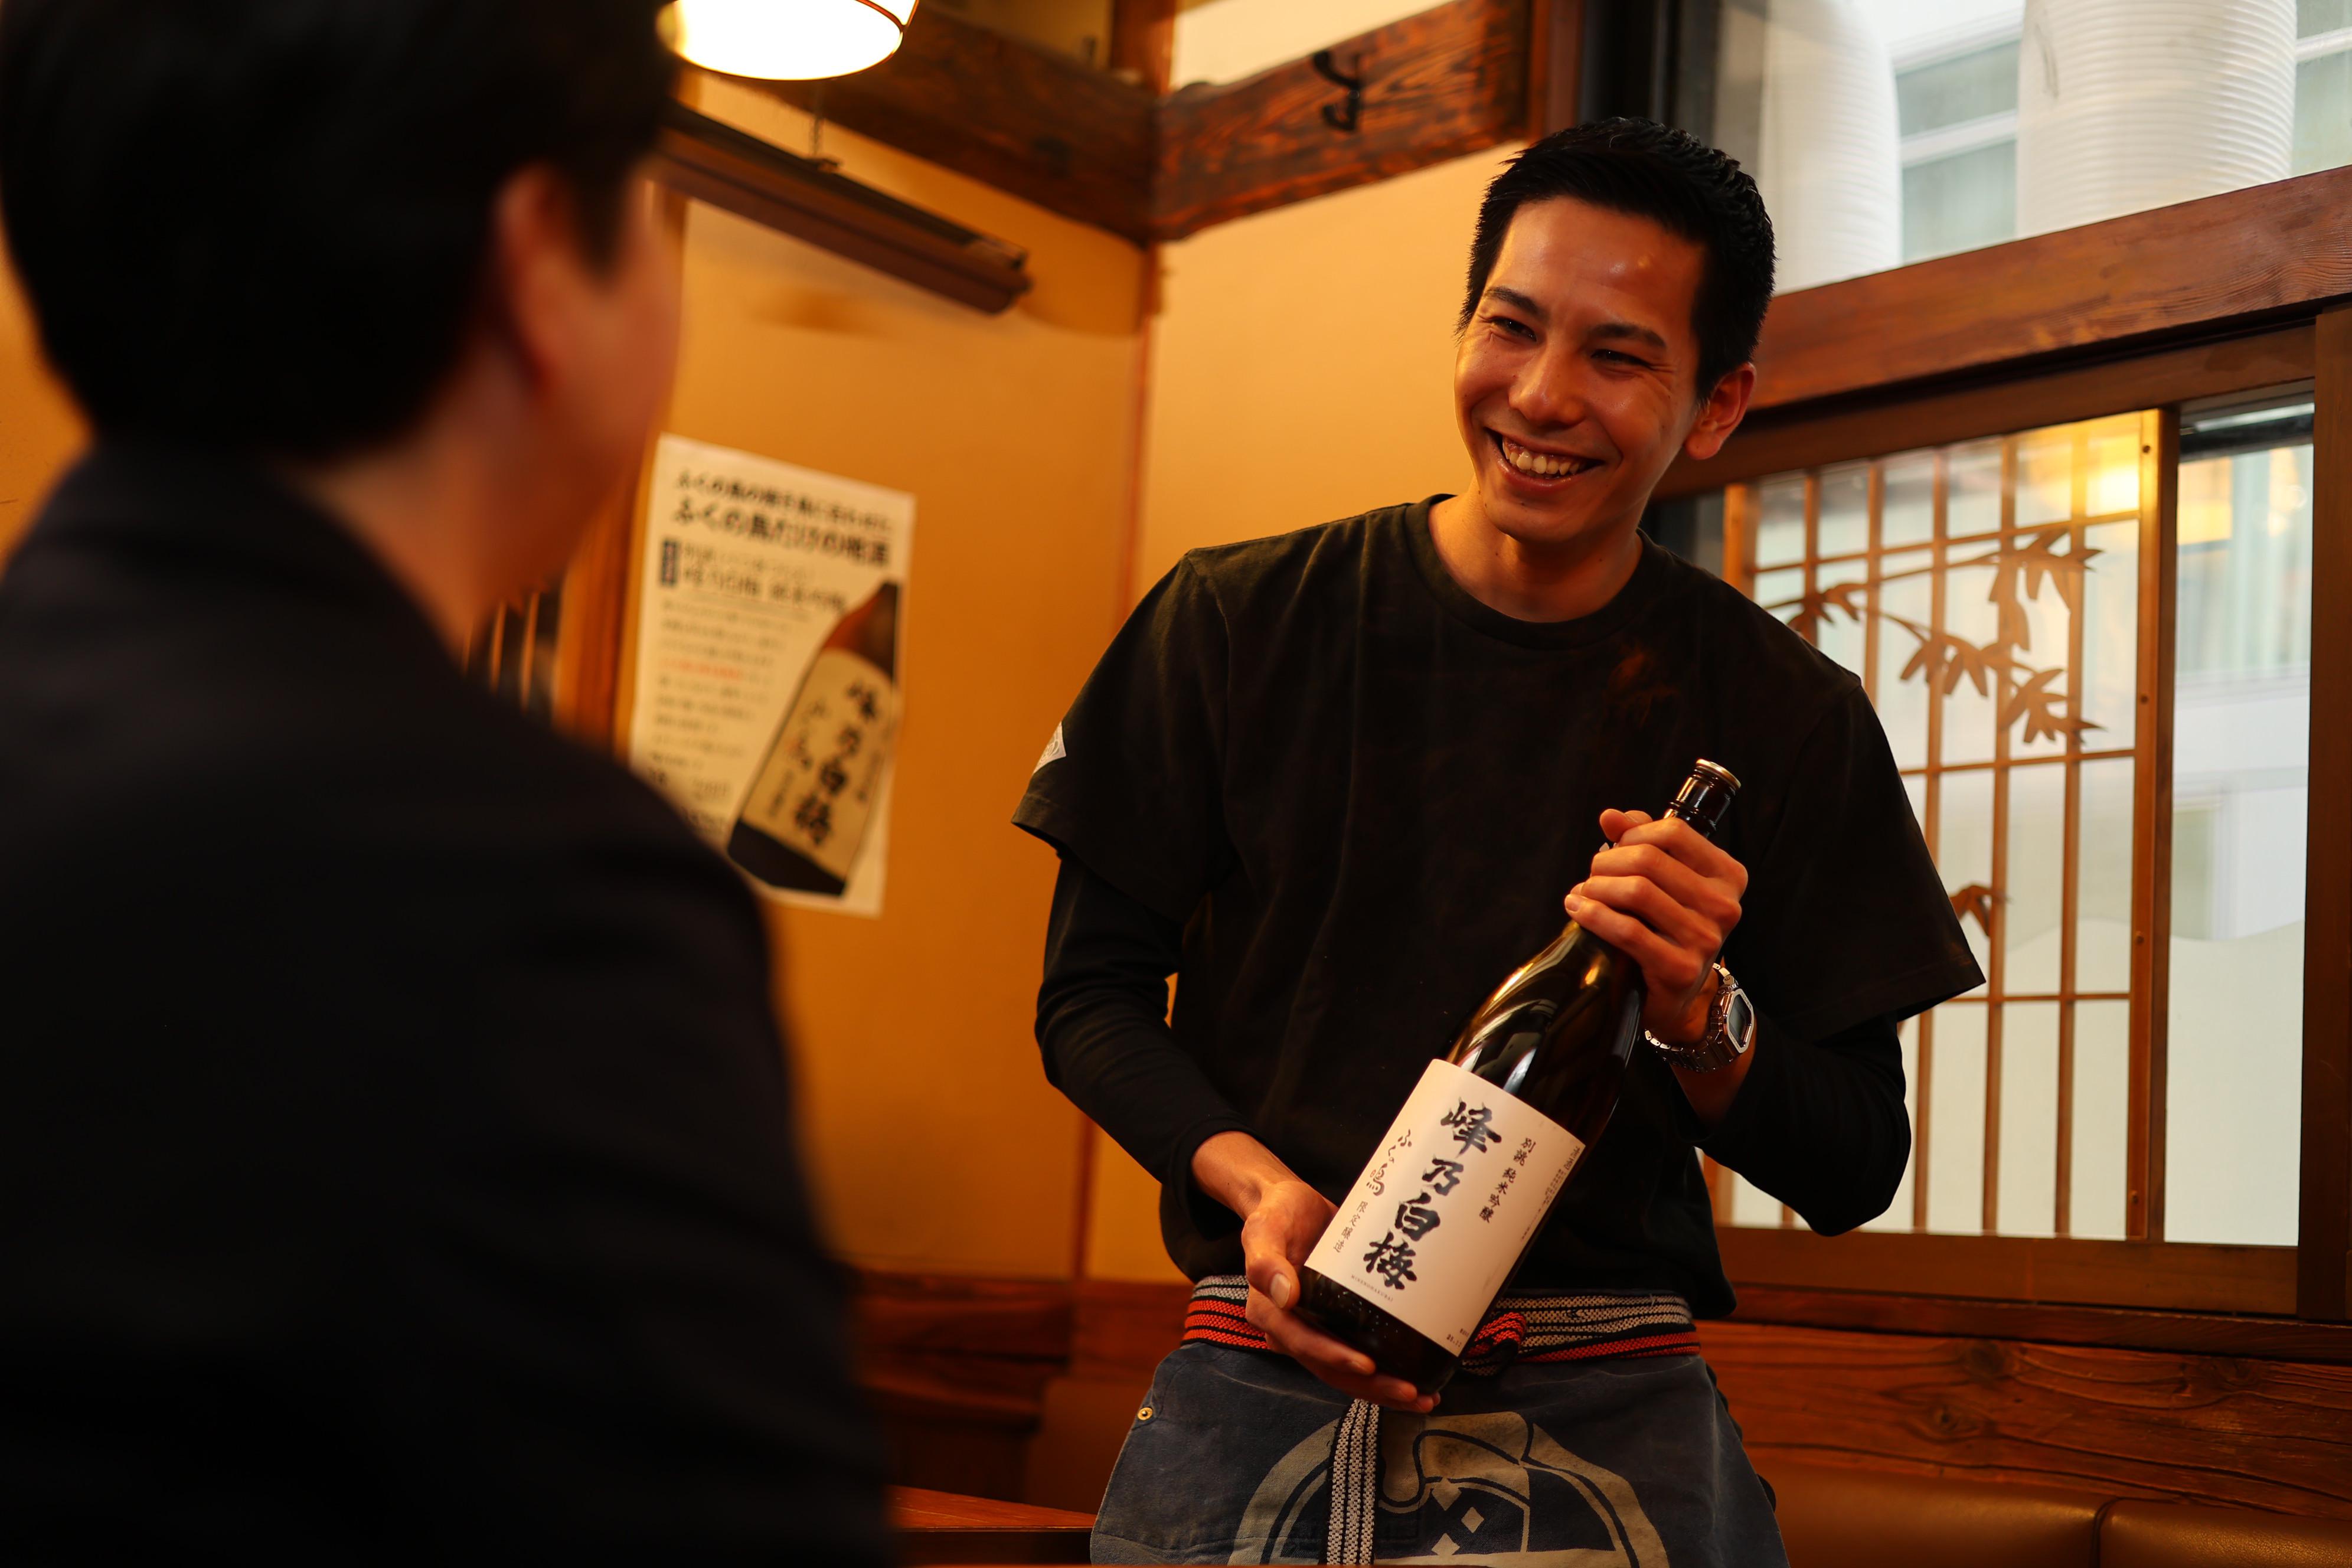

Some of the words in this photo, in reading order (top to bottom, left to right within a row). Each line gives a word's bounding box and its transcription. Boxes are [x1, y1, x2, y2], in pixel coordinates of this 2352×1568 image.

[1363, 1097, 1502, 1290] 峰乃白梅
[1366, 1128, 1412, 1196] ふくの鳥
